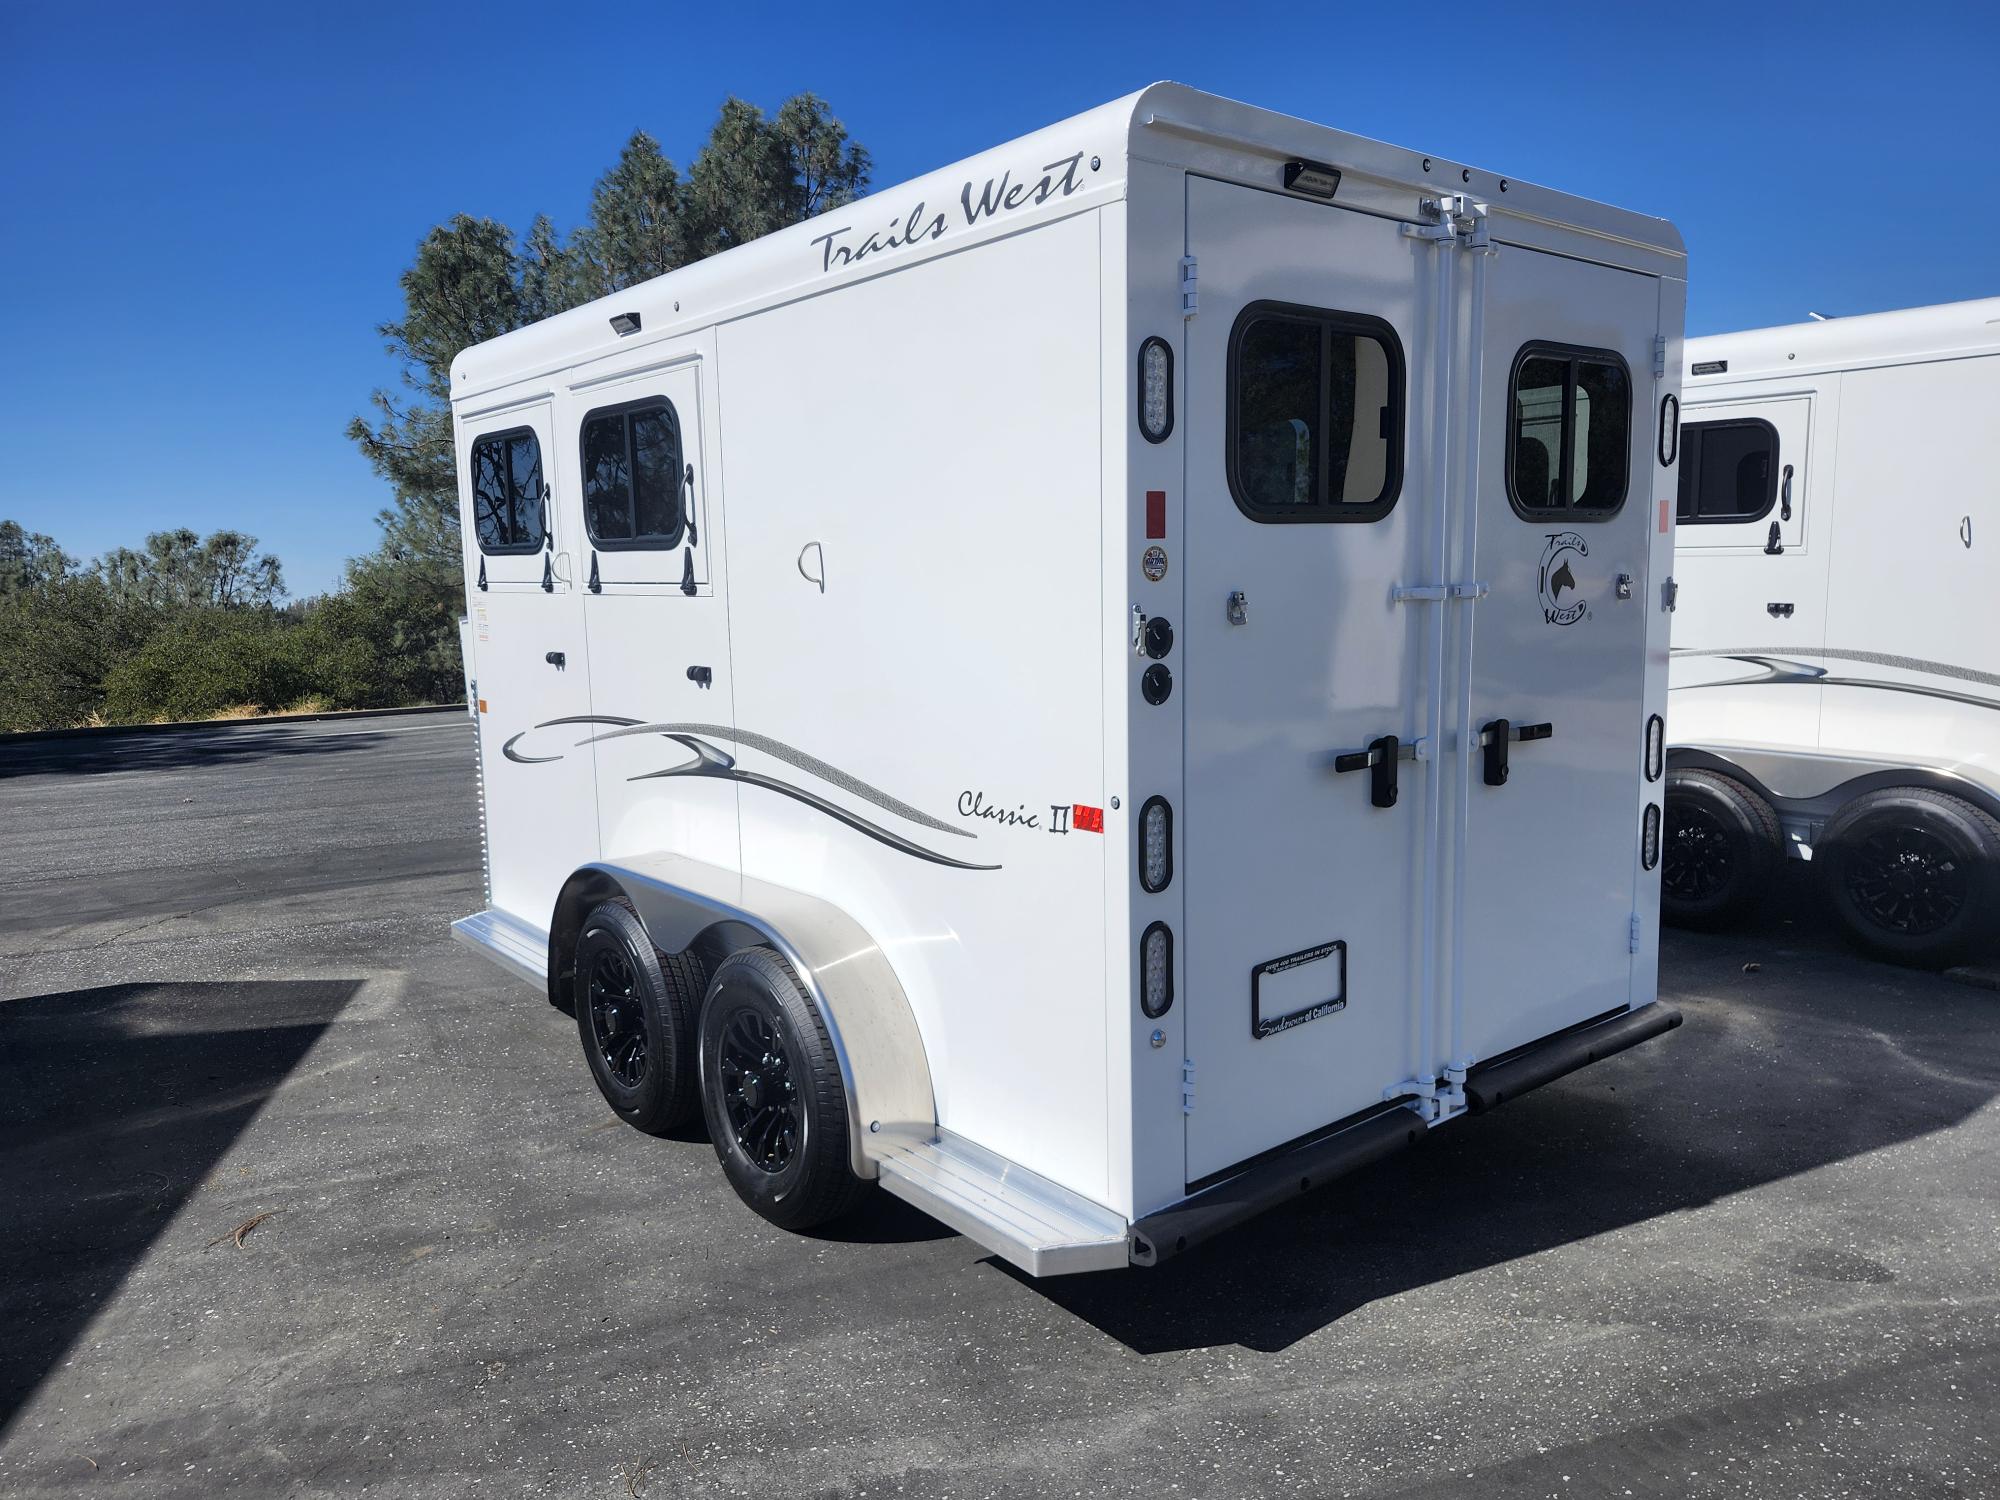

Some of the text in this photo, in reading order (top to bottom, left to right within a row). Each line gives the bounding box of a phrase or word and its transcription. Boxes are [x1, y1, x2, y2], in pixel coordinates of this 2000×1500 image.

[810, 150, 1084, 272] Trails West
[1545, 534, 1581, 550] Trails
[1544, 608, 1577, 625] West
[957, 790, 1071, 835] Classic II
[1265, 962, 1279, 971] OVER
[1280, 959, 1290, 967] 400
[1290, 952, 1314, 963] TRAILERS
[1320, 944, 1337, 954] STOCK
[1259, 1000, 1344, 1038] Sundowner of California
